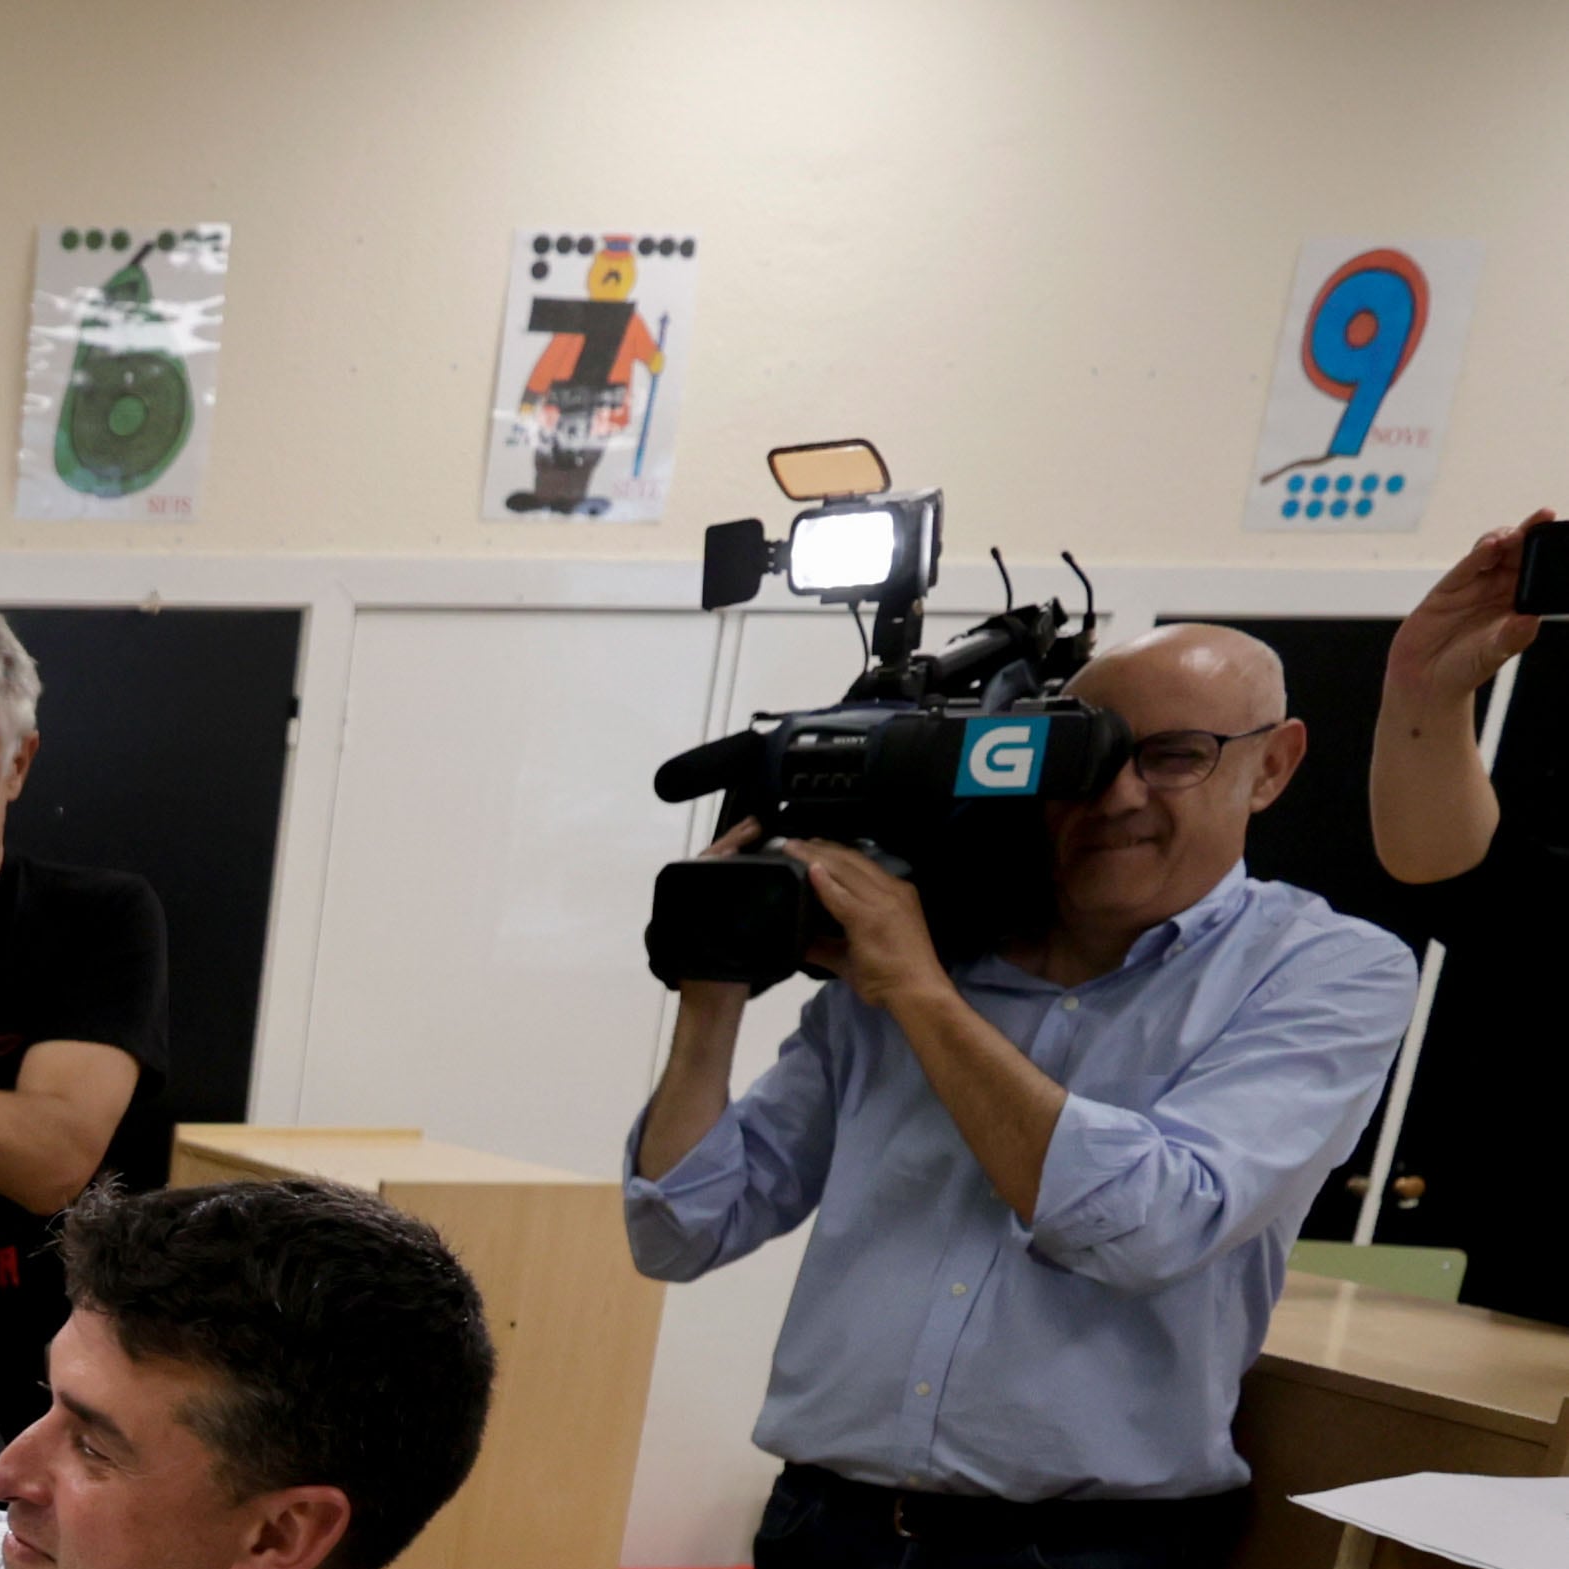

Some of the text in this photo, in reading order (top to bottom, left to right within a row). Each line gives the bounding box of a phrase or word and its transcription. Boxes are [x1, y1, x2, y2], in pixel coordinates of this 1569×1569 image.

[526, 296, 637, 396] 7
[1310, 267, 1418, 458] 9
[1371, 426, 1433, 448] NOVE
[833, 735, 867, 746] SONY
[968, 725, 1035, 788] G
